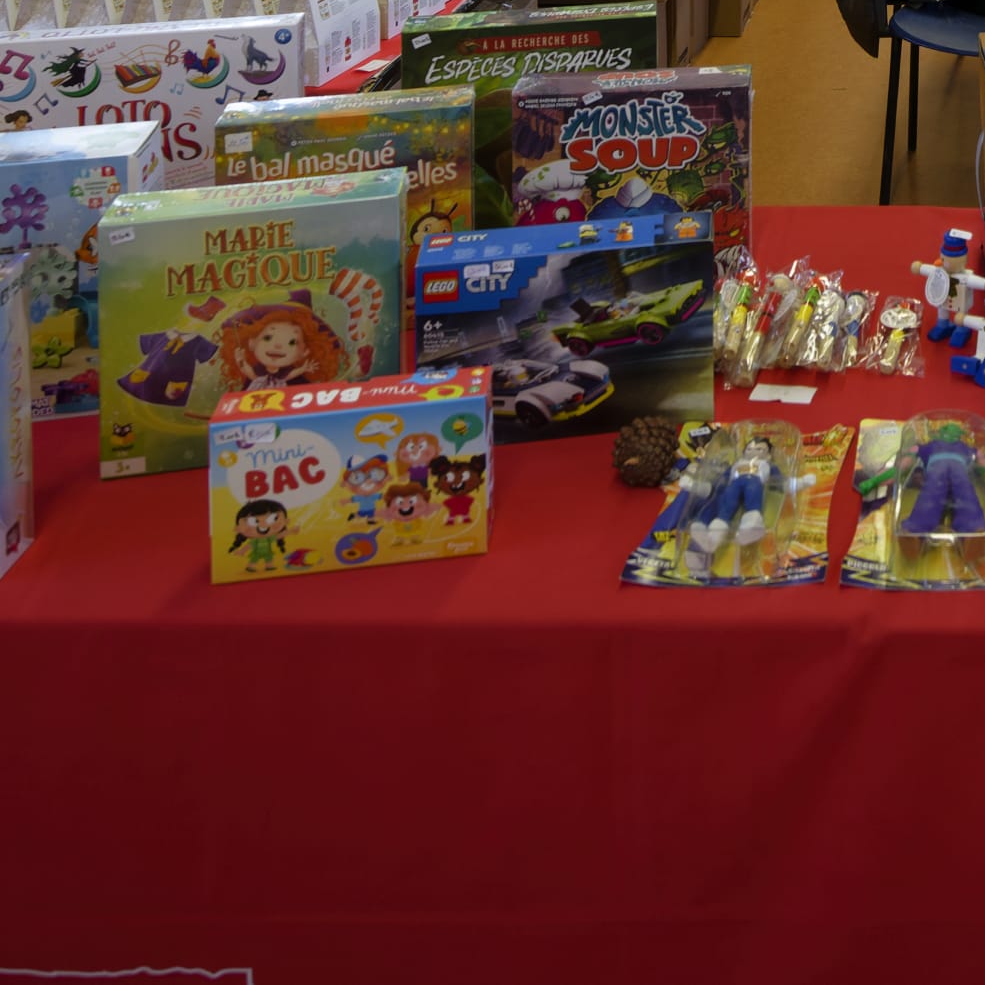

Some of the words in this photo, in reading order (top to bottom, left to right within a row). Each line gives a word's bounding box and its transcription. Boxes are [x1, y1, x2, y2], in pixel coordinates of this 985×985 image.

[494, 38, 506, 50] LA
[511, 35, 566, 48] RECHERCHE
[571, 33, 590, 45] DES
[521, 47, 633, 78] DISPARUES
[76, 99, 172, 129] LOTO
[560, 95, 707, 143] MONSTER
[226, 157, 246, 178] Le
[250, 151, 291, 182] bal
[296, 139, 396, 176] masqué
[565, 134, 701, 174] SOUP
[406, 158, 458, 190] elles
[457, 233, 488, 245] CITY
[424, 278, 456, 296] LEGO
[465, 271, 513, 295] CITY
[423, 319, 443, 332] 6+
[290, 386, 363, 409] BAC
[245, 456, 326, 498] BAC
